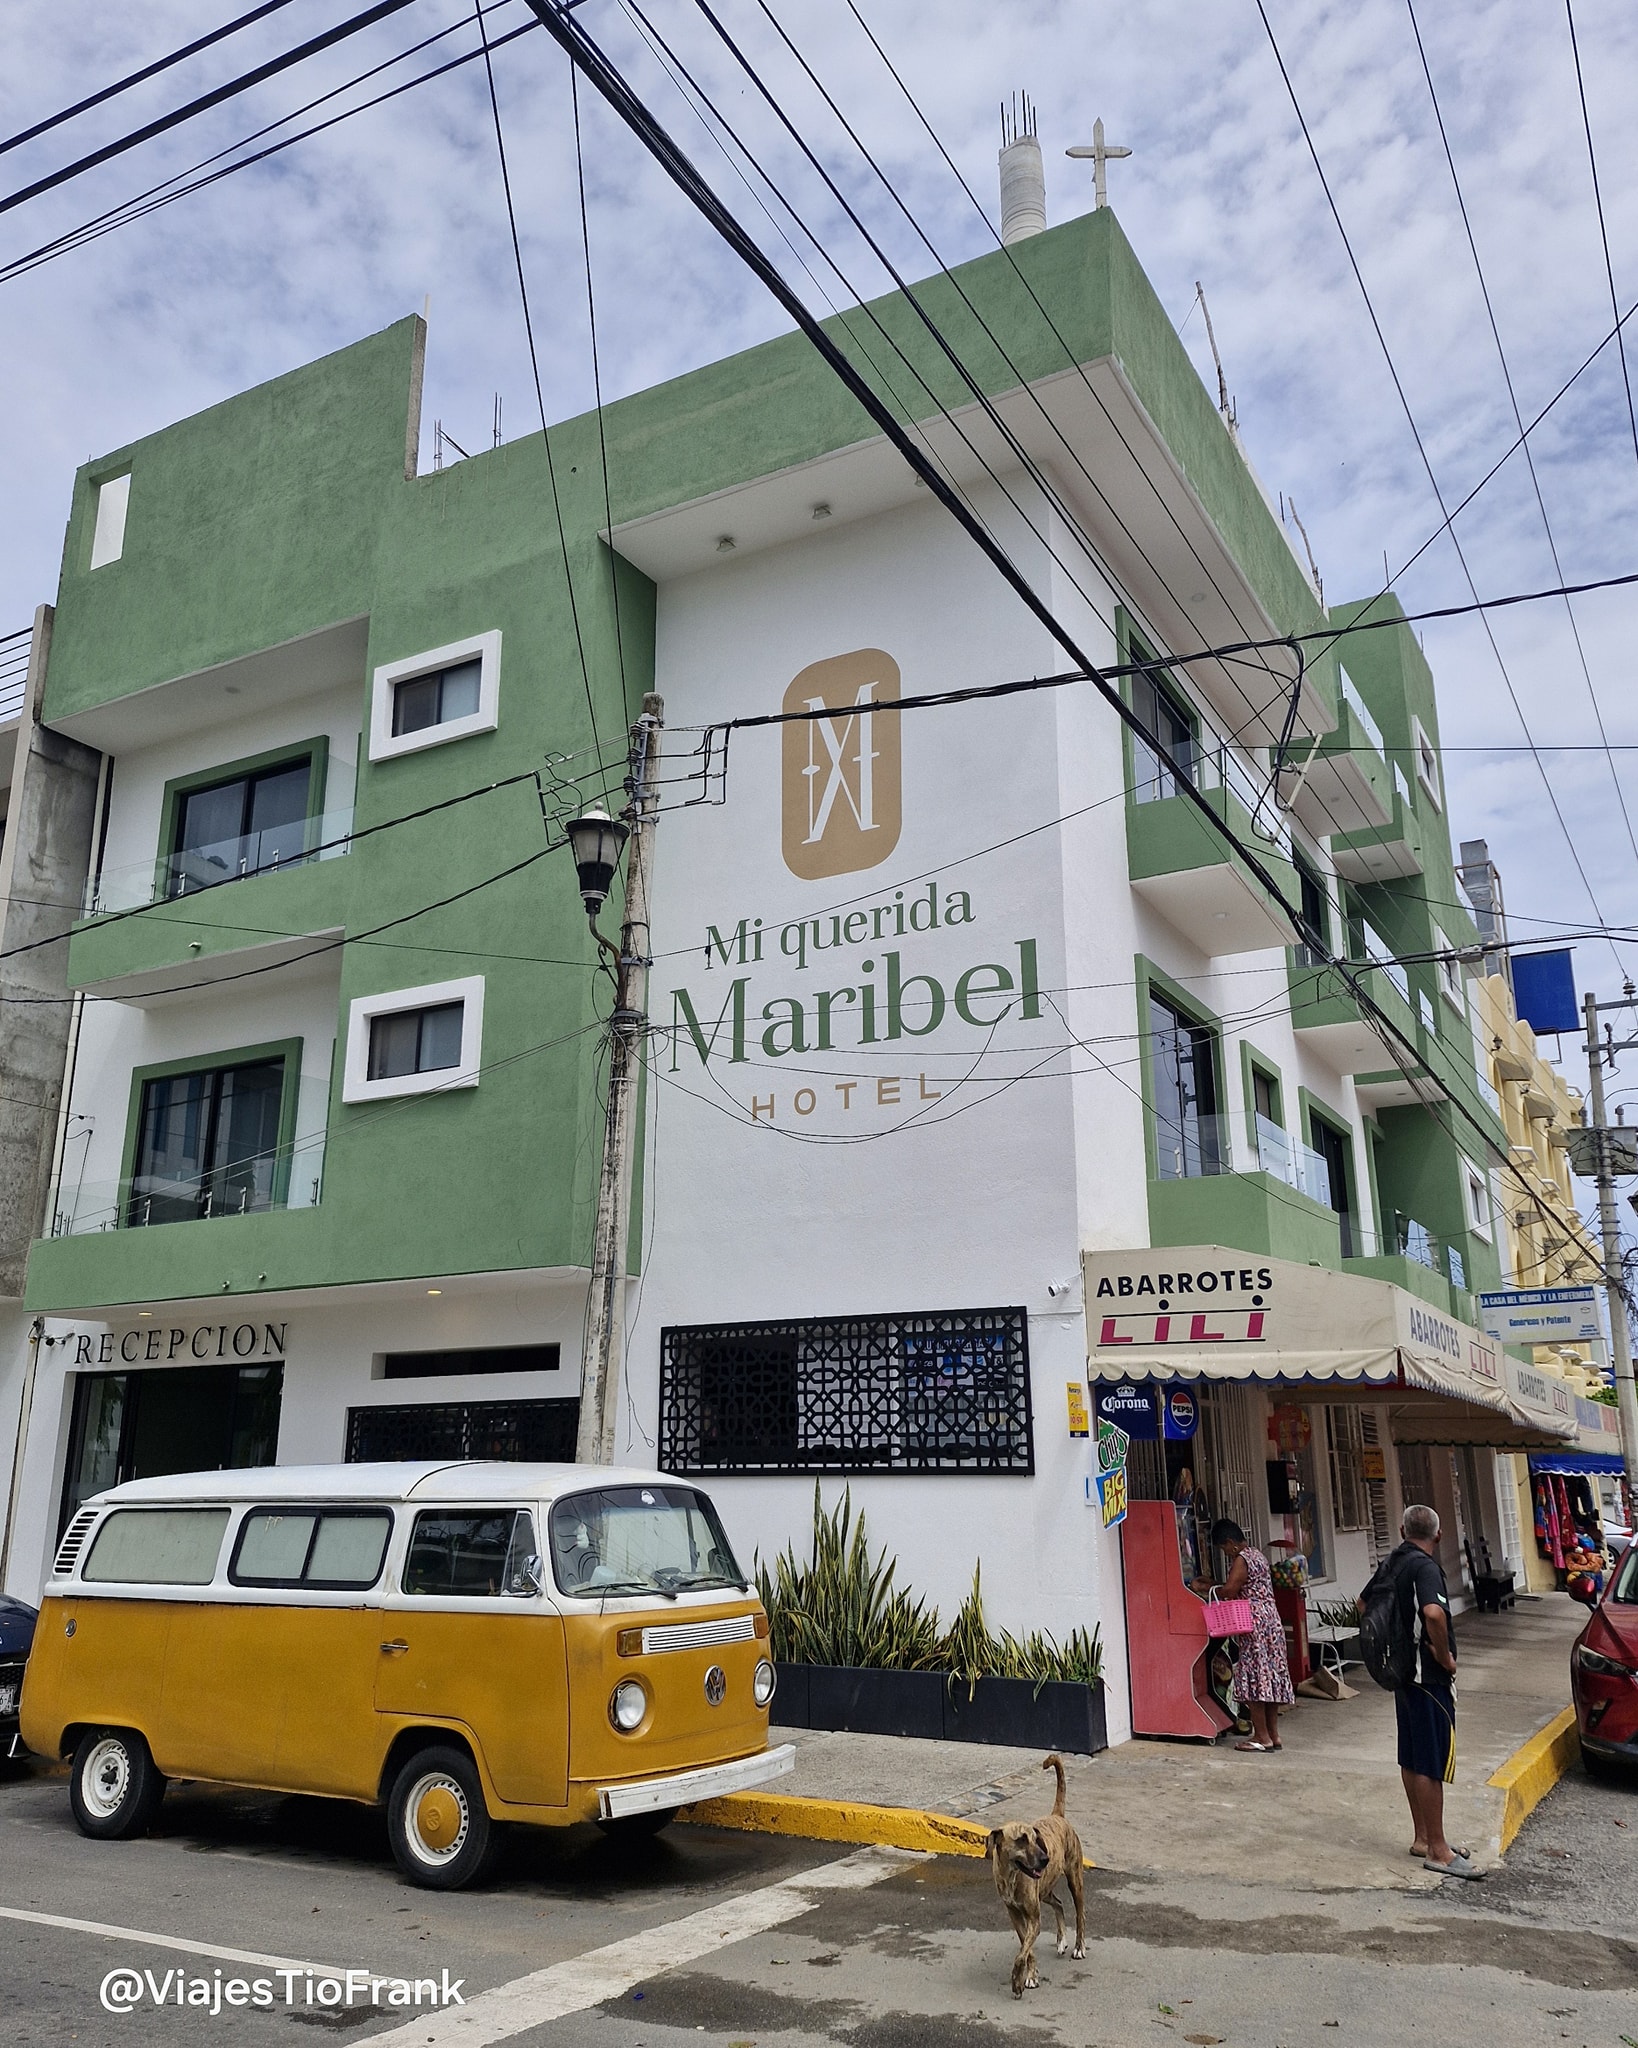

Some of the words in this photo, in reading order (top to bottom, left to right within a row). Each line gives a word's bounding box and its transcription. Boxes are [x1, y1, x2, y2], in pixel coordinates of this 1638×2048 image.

[705, 918, 764, 970] Mi
[780, 882, 976, 970] querida
[668, 938, 1044, 1073] Maribel
[751, 1073, 943, 1121] HOTEL
[1096, 1268, 1273, 1298] ABARROTES
[74, 1323, 288, 1364] RECEPCION
[1410, 1307, 1461, 1359] ABARROTES
[1101, 1396, 1150, 1413] Corona
[1172, 1404, 1193, 1414] PEPSI
[1103, 1468, 1126, 1499] BIG
[1102, 1489, 1127, 1529] MIX
